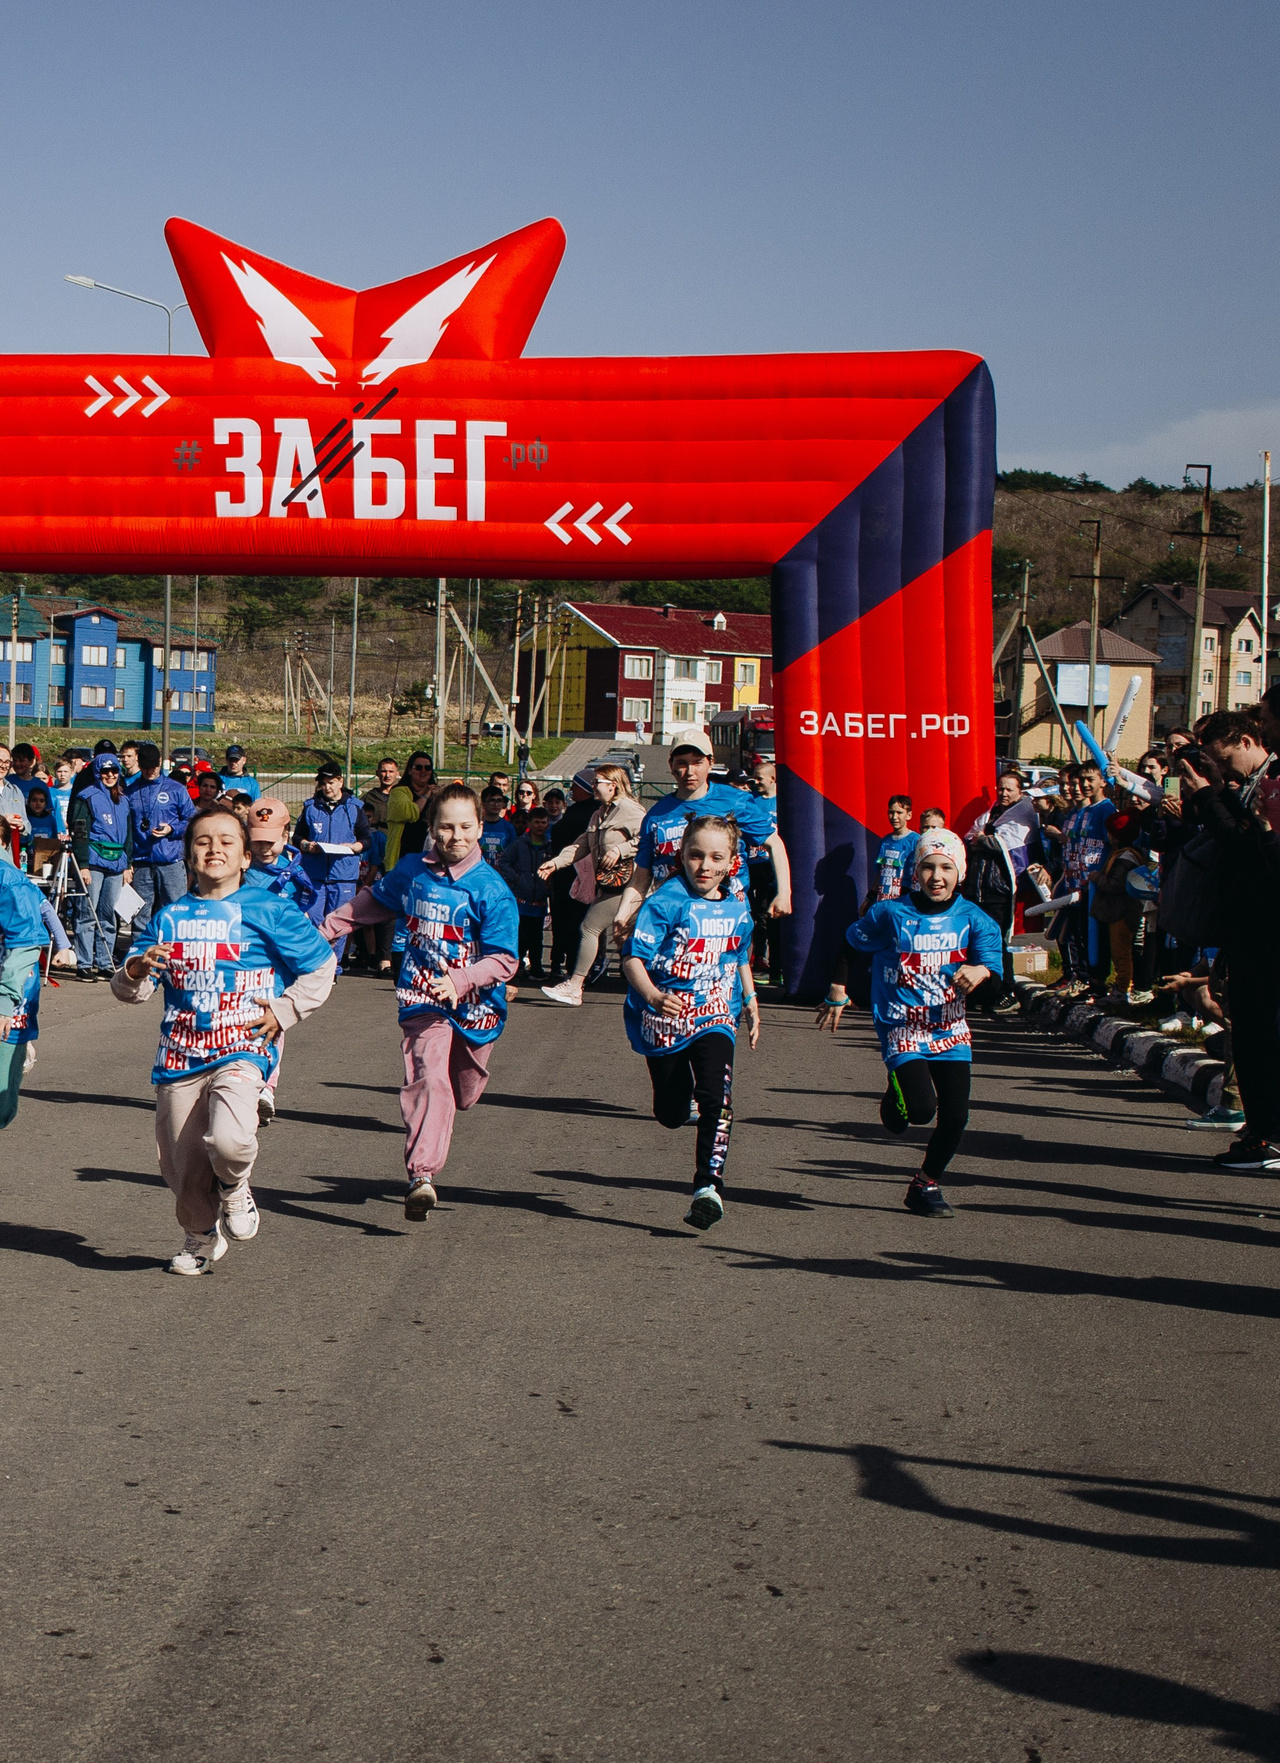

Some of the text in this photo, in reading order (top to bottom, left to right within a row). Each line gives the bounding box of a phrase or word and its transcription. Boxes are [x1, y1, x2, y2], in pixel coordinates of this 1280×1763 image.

[800, 710, 970, 739] ЗАБЕГ.РФ
[415, 899, 451, 922] 00513
[177, 919, 228, 940] 00509
[634, 928, 656, 944] ПСБ
[701, 918, 736, 937] 00517
[913, 932, 958, 951] 00520
